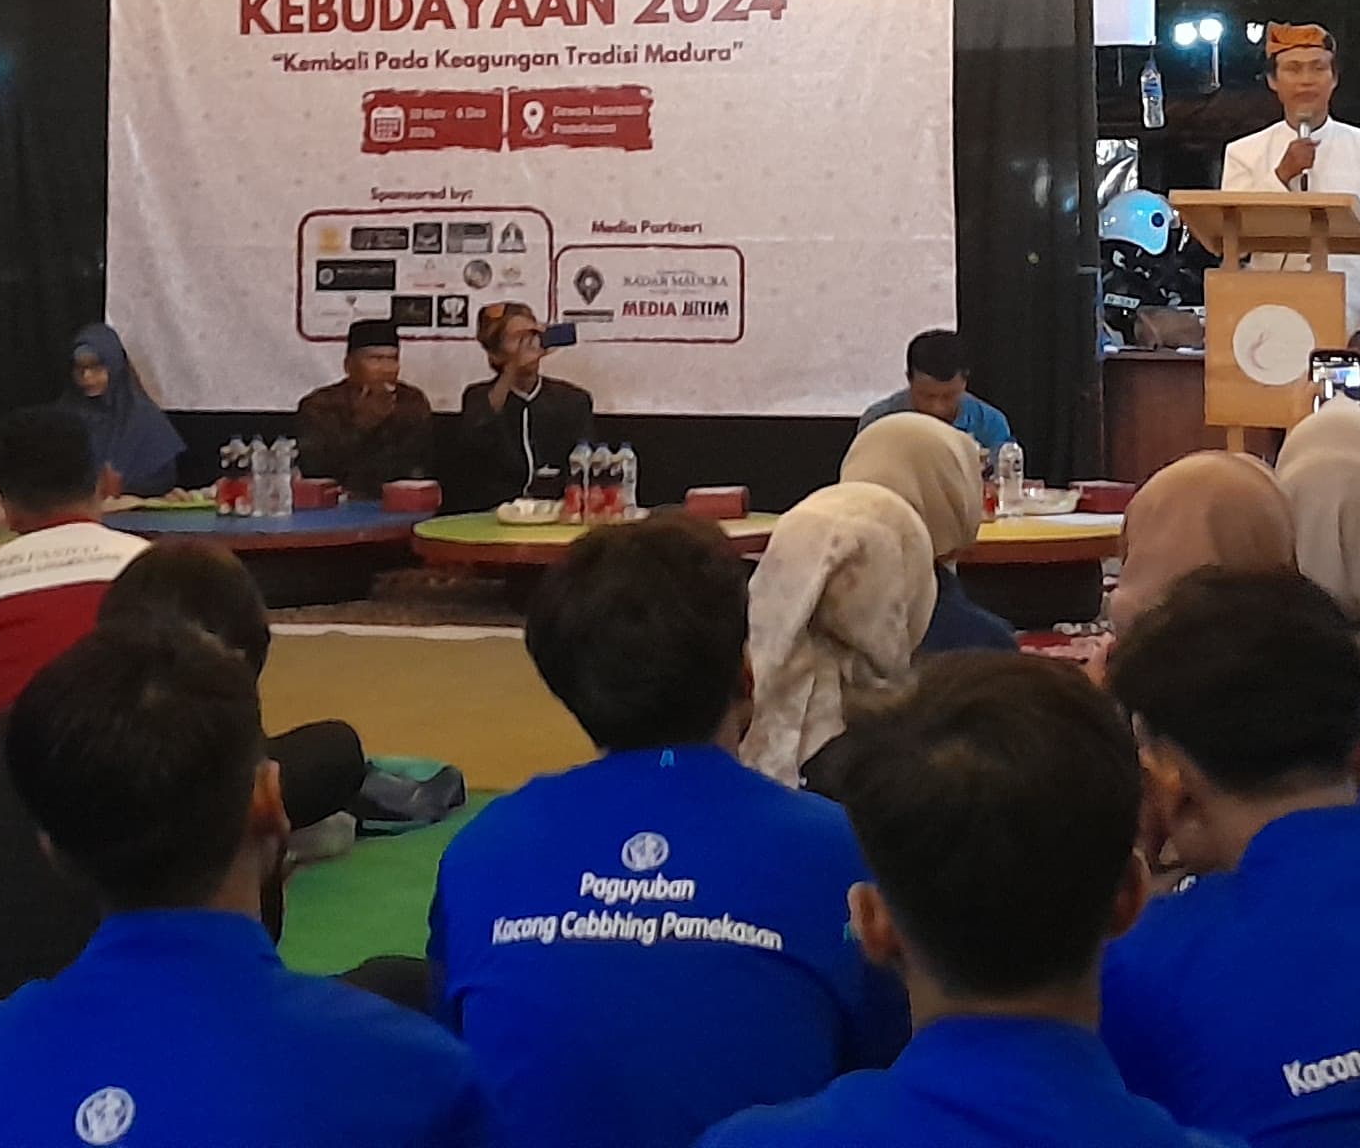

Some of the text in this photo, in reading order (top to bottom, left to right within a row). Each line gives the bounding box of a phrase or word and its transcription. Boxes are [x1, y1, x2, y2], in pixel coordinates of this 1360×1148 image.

[375, 49, 428, 70] Pada
[435, 48, 559, 73] Keagungan
[565, 43, 638, 65] Tradisi
[591, 219, 637, 235] Media
[622, 300, 677, 317] MEDIA
[580, 871, 695, 905] Paguyuban
[492, 910, 783, 952] Kacong Cebbhing Pamekasan
